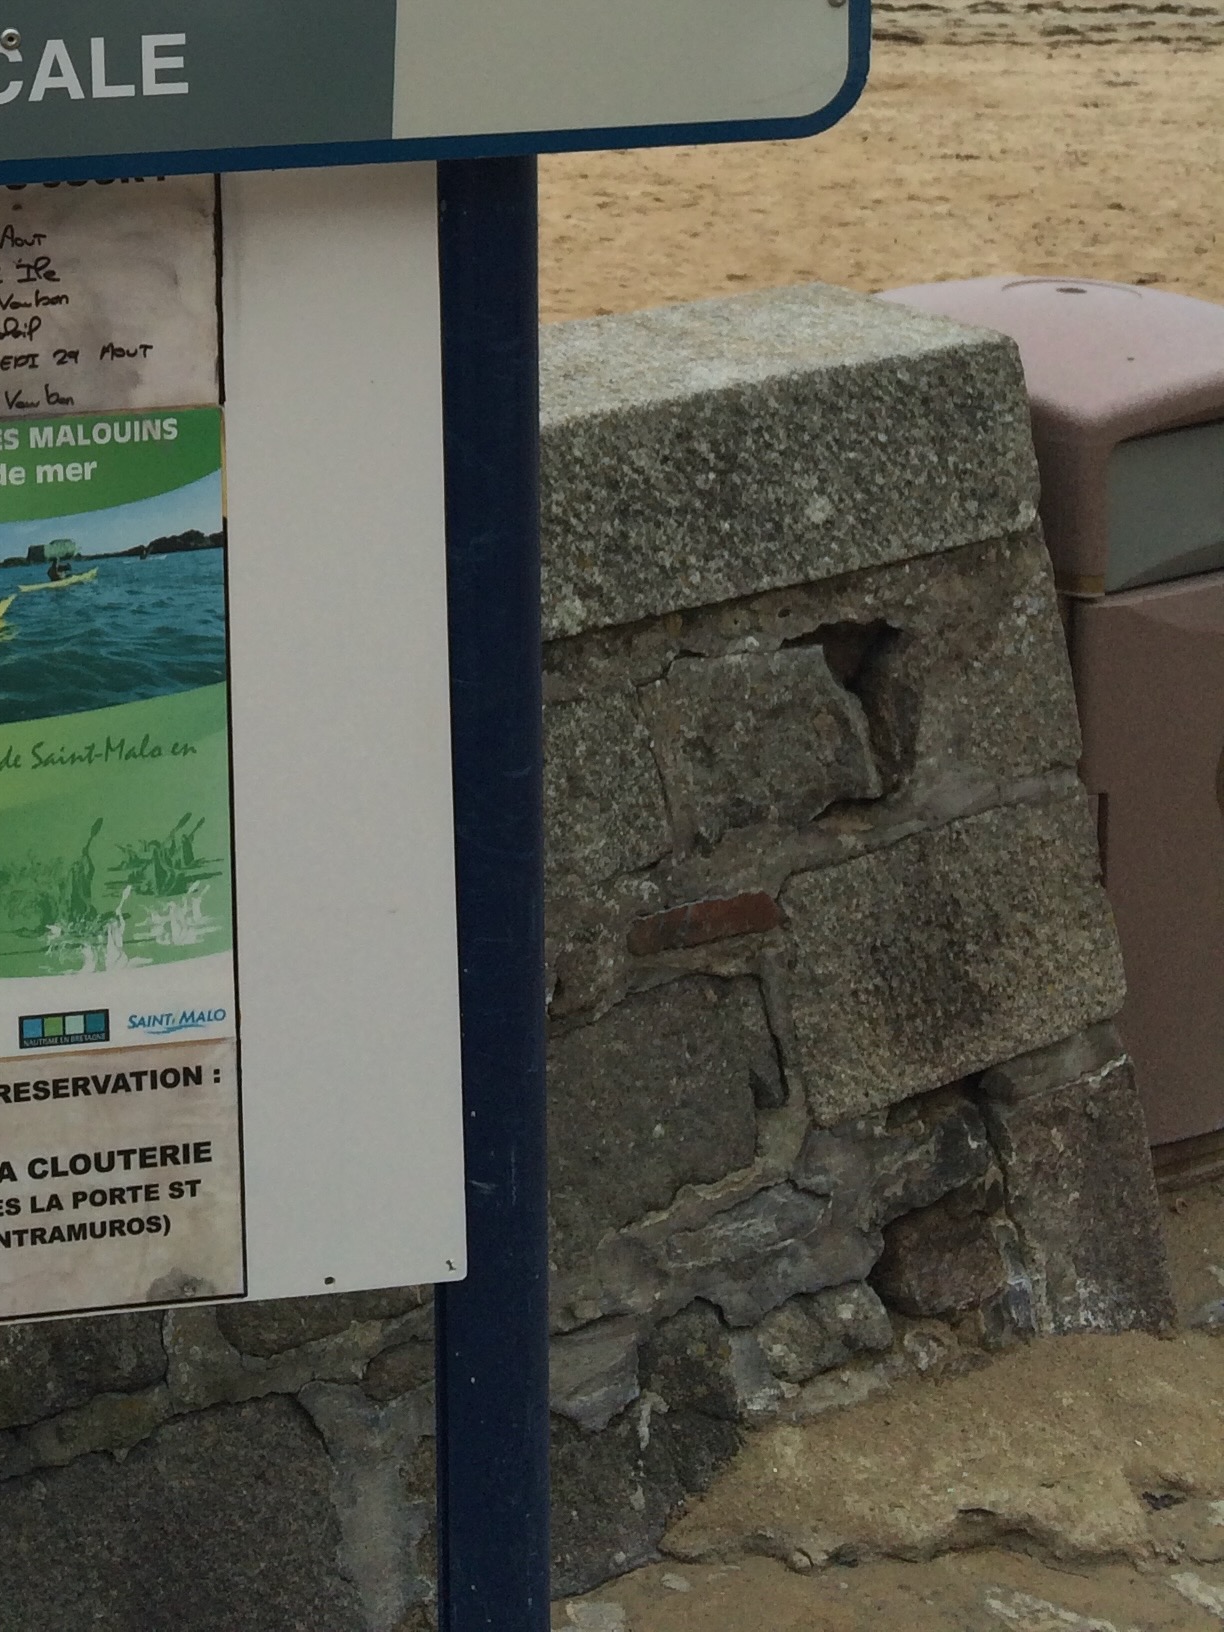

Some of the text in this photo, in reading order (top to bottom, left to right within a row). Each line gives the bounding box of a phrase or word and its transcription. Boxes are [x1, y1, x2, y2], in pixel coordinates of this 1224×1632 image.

[29, 417, 179, 451] MALOUINS
[36, 457, 98, 483] mer
[31, 733, 163, 770] Saint-Malo
[170, 740, 198, 758] en
[179, 1008, 227, 1025] MALO
[27, 1140, 214, 1180] CLOUTERIE
[29, 1193, 64, 1215] LA
[72, 1184, 161, 1210] PORTE
[167, 1178, 203, 1200] ST
